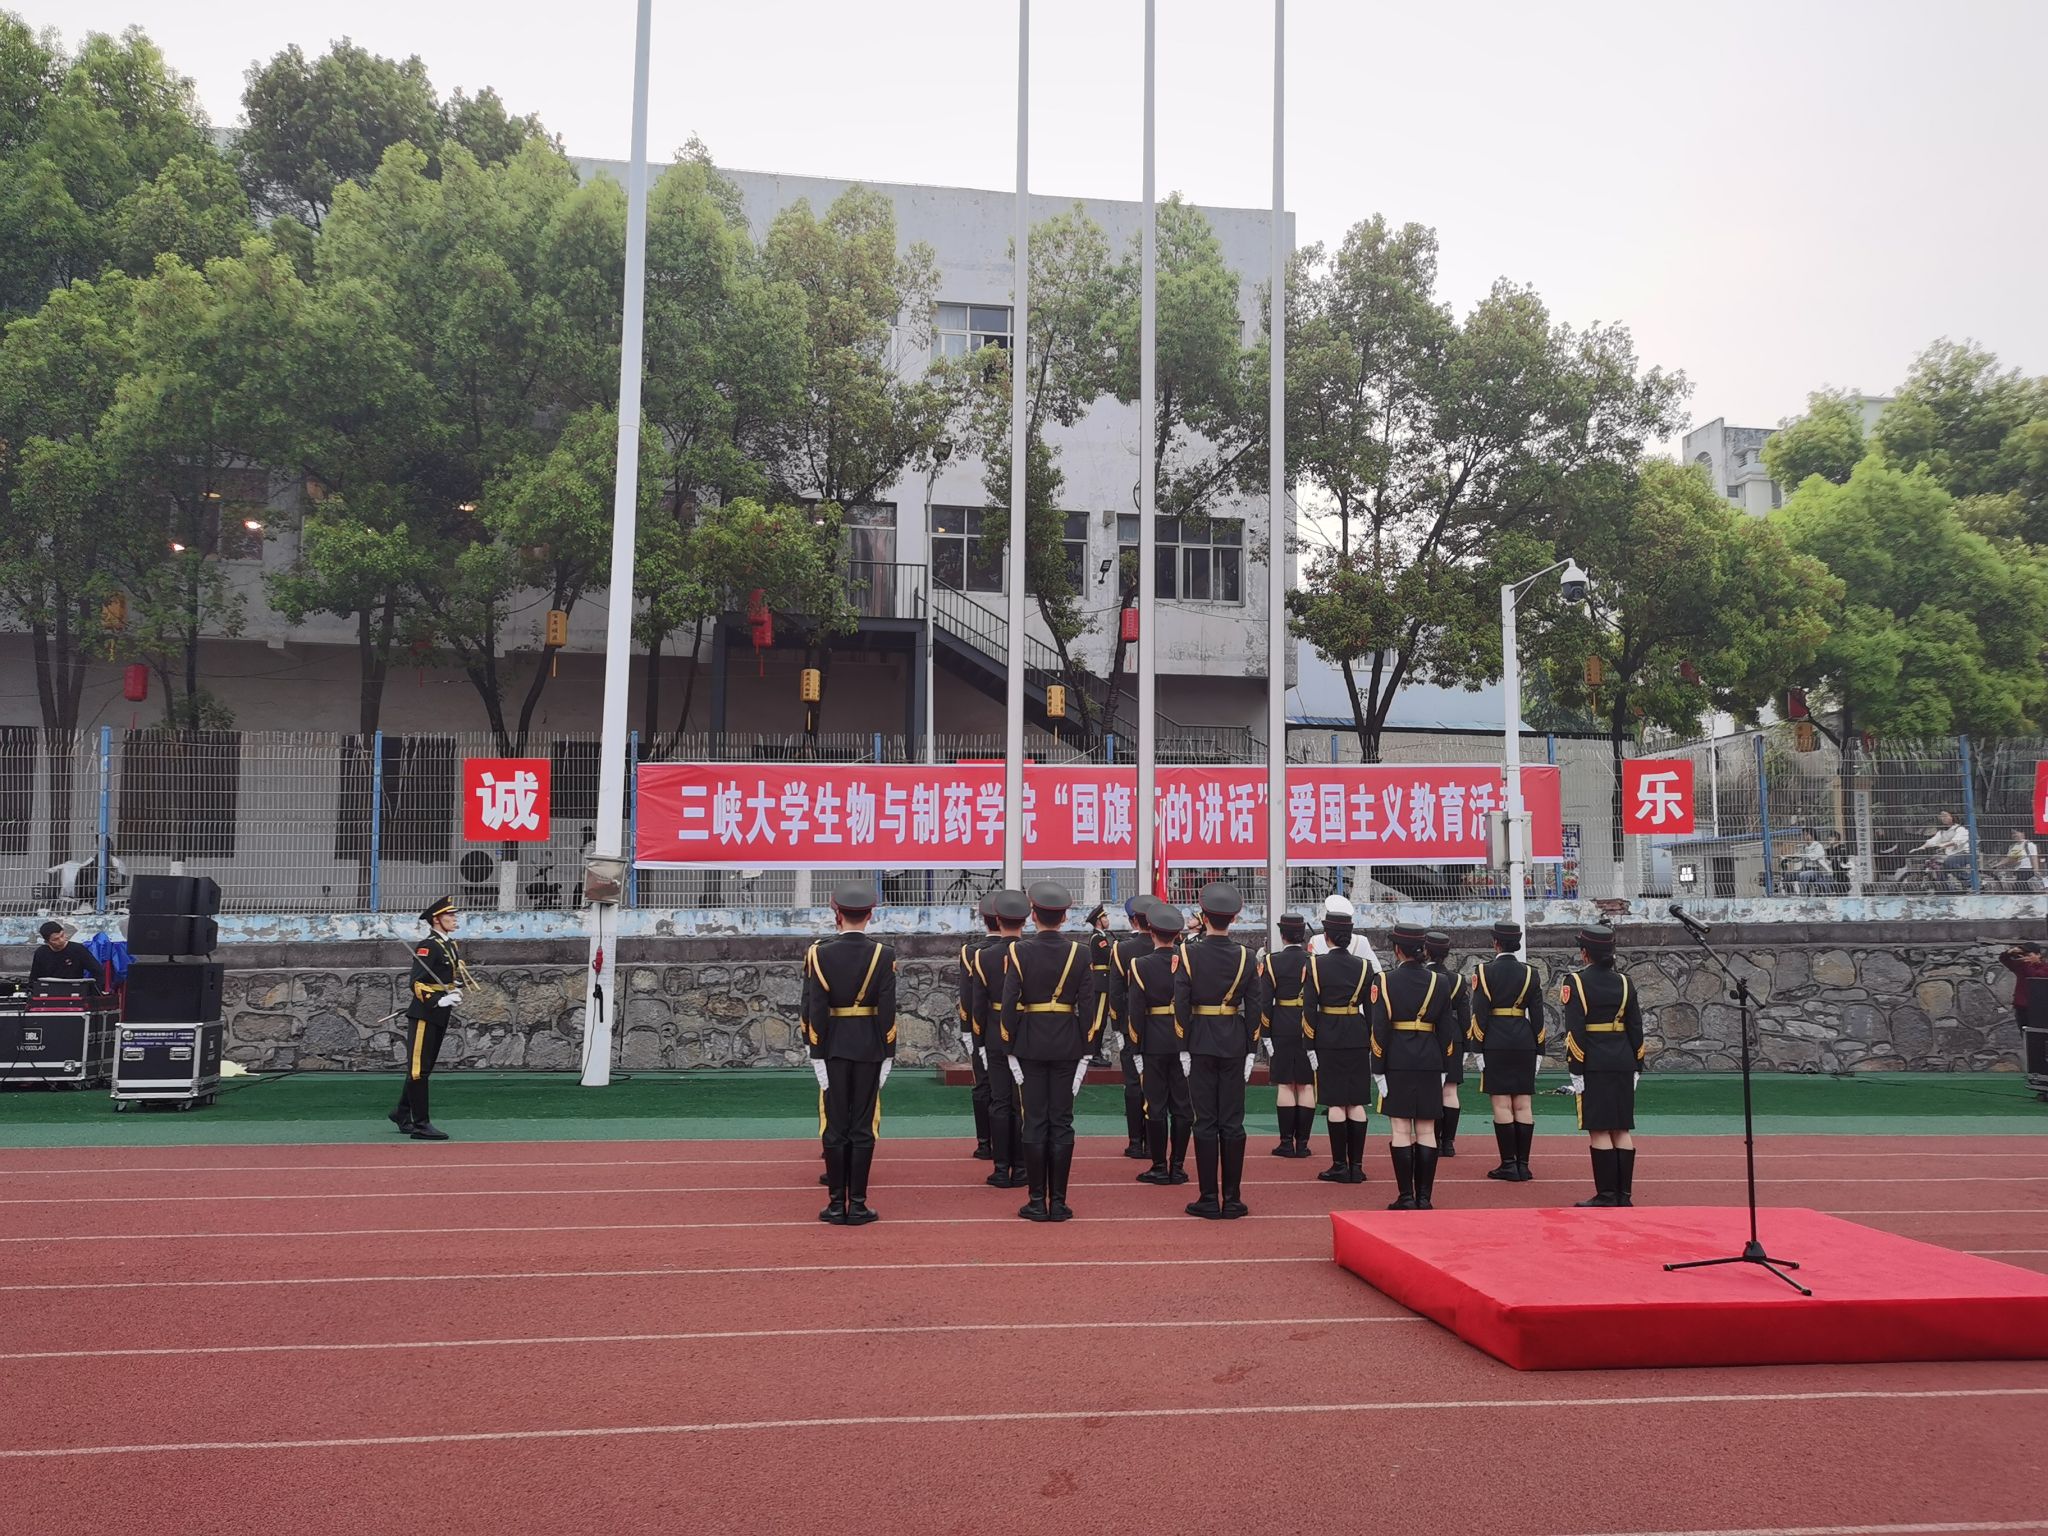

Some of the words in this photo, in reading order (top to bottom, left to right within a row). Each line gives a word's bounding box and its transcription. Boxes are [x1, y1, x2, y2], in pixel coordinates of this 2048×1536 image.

[476, 771, 540, 831] 诚
[1634, 770, 1685, 825] 乐
[25, 1032, 39, 1041] JBL
